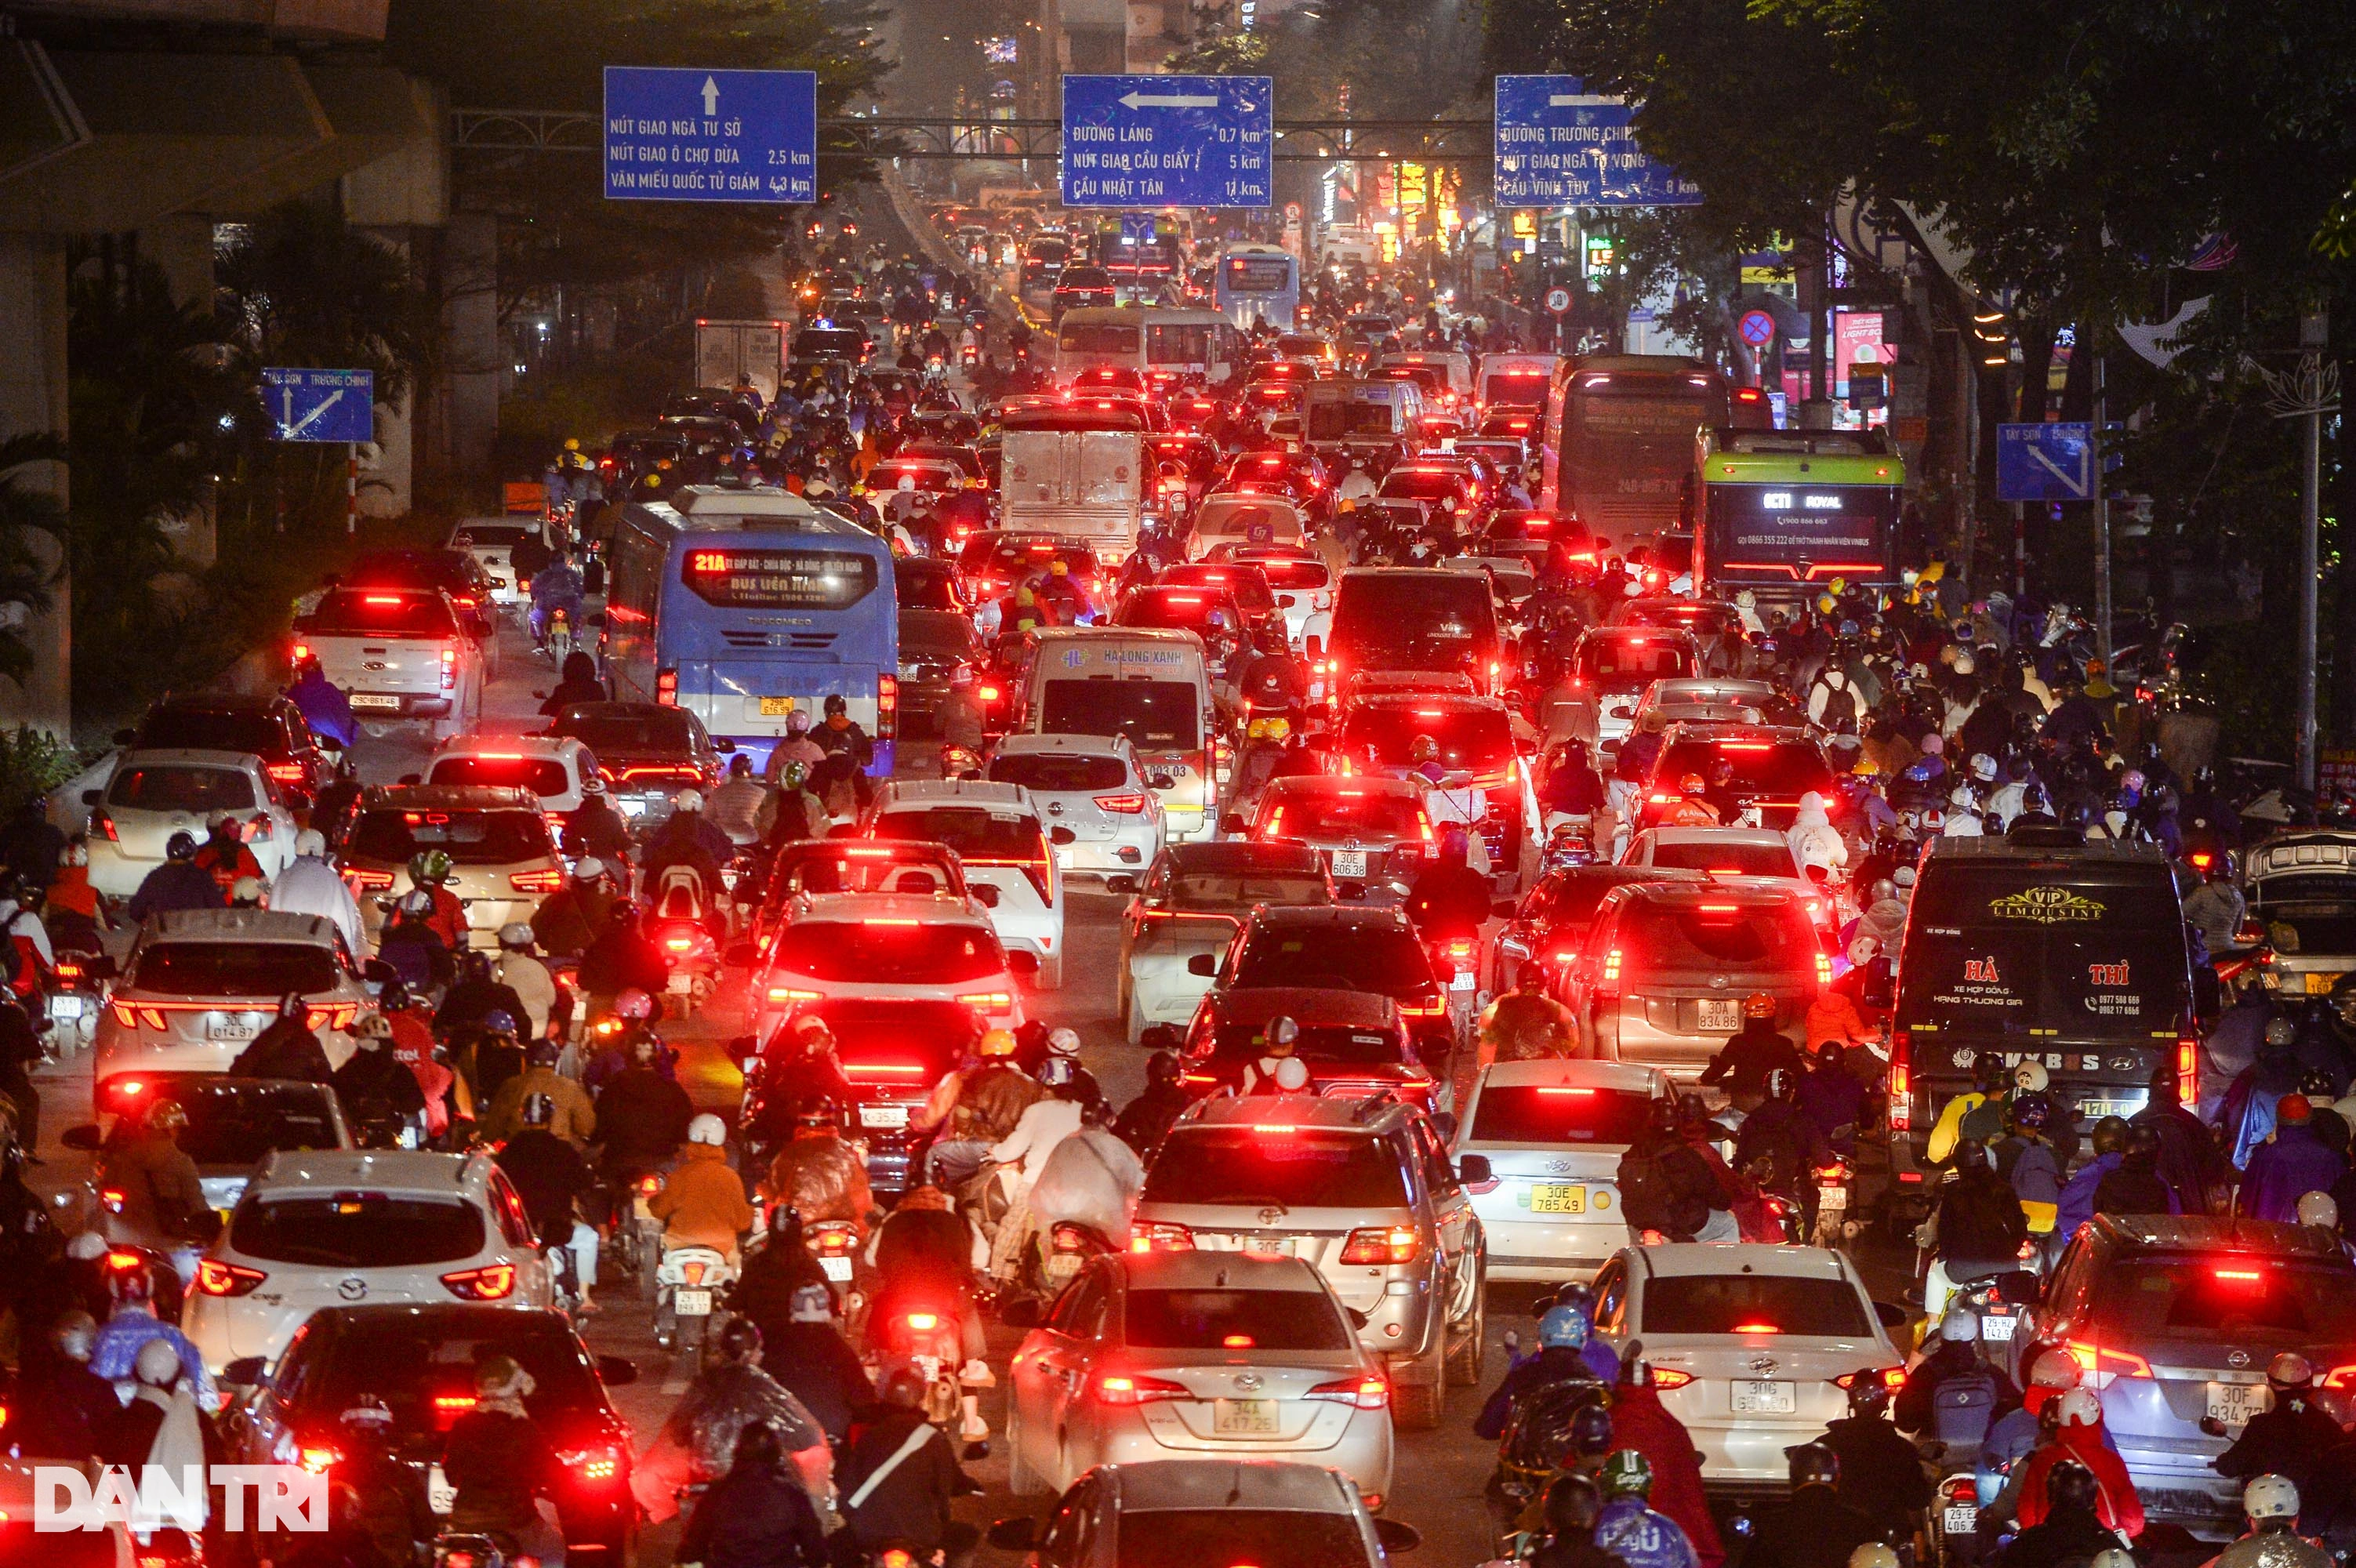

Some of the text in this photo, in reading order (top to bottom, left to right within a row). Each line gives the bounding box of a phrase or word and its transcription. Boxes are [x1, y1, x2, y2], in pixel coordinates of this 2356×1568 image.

[611, 116, 633, 134] NÚT
[639, 120, 666, 135] GIAO
[672, 118, 696, 136] NGÃ
[724, 117, 742, 136] SỞ
[1120, 123, 1153, 141] LÁNG
[1219, 129, 1236, 143] 0.7
[1242, 129, 1260, 142] km
[1604, 126, 1640, 141] CHIN
[611, 142, 810, 165] NÚT GIAO Ô CHỢ DỪA 2.5 km
[1073, 149, 1260, 169] NÚT GIAO CẦU GIẤY 5 km
[1532, 154, 1559, 169] GIAO
[1563, 151, 1587, 169] NGÃ
[612, 170, 634, 187] VĂN
[639, 169, 667, 188] MIẾU
[673, 170, 705, 189] QUỐC
[730, 172, 759, 190] GIÁM
[791, 176, 810, 191] km
[1073, 176, 1096, 195] CẦU
[1102, 178, 1134, 197] NHẬT
[1140, 179, 1163, 194] TÂN
[1242, 182, 1260, 195] km
[1667, 180, 1672, 193] 8
[1678, 180, 1698, 194] km
[1806, 495, 1842, 508] ROYAL
[1777, 536, 1788, 545] 222
[695, 554, 725, 571] 21A
[1122, 651, 1149, 662] LONG
[1153, 652, 1182, 663] XANH
[1341, 854, 1358, 864] 30E
[1333, 865, 1365, 876] 606.38
[2035, 891, 2061, 903] VIP
[1994, 906, 2102, 918] LIMOUSINE
[1964, 956, 2129, 985] HÀ THÌ
[1708, 1003, 1728, 1014] 30A
[2006, 998, 2023, 1007] GIA
[223, 1016, 244, 1026] 30L
[1700, 1015, 1737, 1028] 834.86
[214, 1028, 253, 1037] 014.87
[2085, 1102, 2129, 1116] 17H-0
[1548, 1188, 1570, 1198] 30E
[1538, 1200, 1579, 1211] 785.49
[1988, 1318, 2011, 1328] 29-H2
[1987, 1329, 2013, 1339] 142.9
[1749, 1381, 1777, 1395] 30G
[2222, 1387, 2251, 1404] 30F
[1948, 1521, 1977, 1531] 406.2
